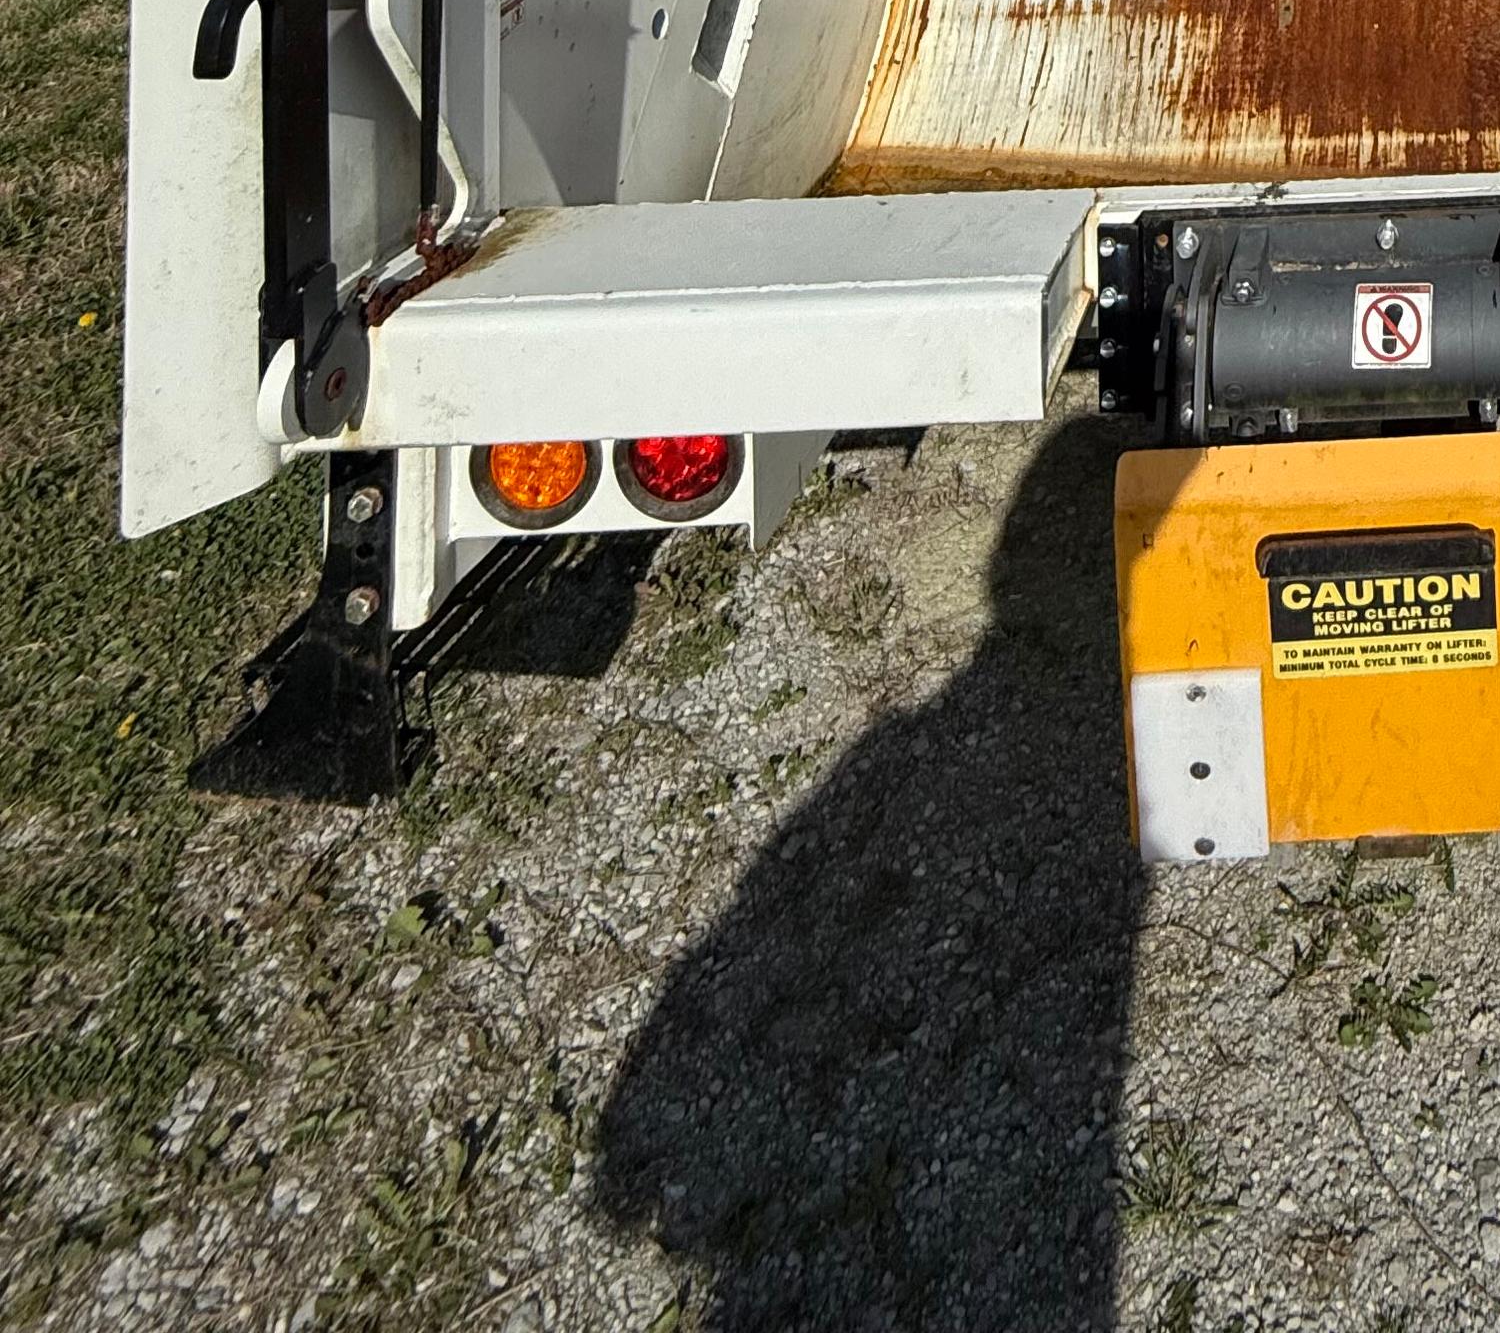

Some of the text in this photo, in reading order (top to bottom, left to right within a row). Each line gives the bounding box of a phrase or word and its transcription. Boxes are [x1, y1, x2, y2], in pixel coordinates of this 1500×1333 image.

[1281, 573, 1481, 610] CAUTION
[1312, 604, 1453, 624] KEEP CLEAR OF
[1314, 617, 1452, 636] MOVING LIFTER
[1283, 639, 1487, 659] TO MAINTAIN WARRANTY ON LIFTER:
[1280, 662, 1324, 672] MINIMUM
[1328, 660, 1360, 669] TOTAL
[1364, 657, 1396, 667] CYCLE
[1400, 655, 1428, 666] TIME:
[1443, 651, 1492, 663] SECONDS
